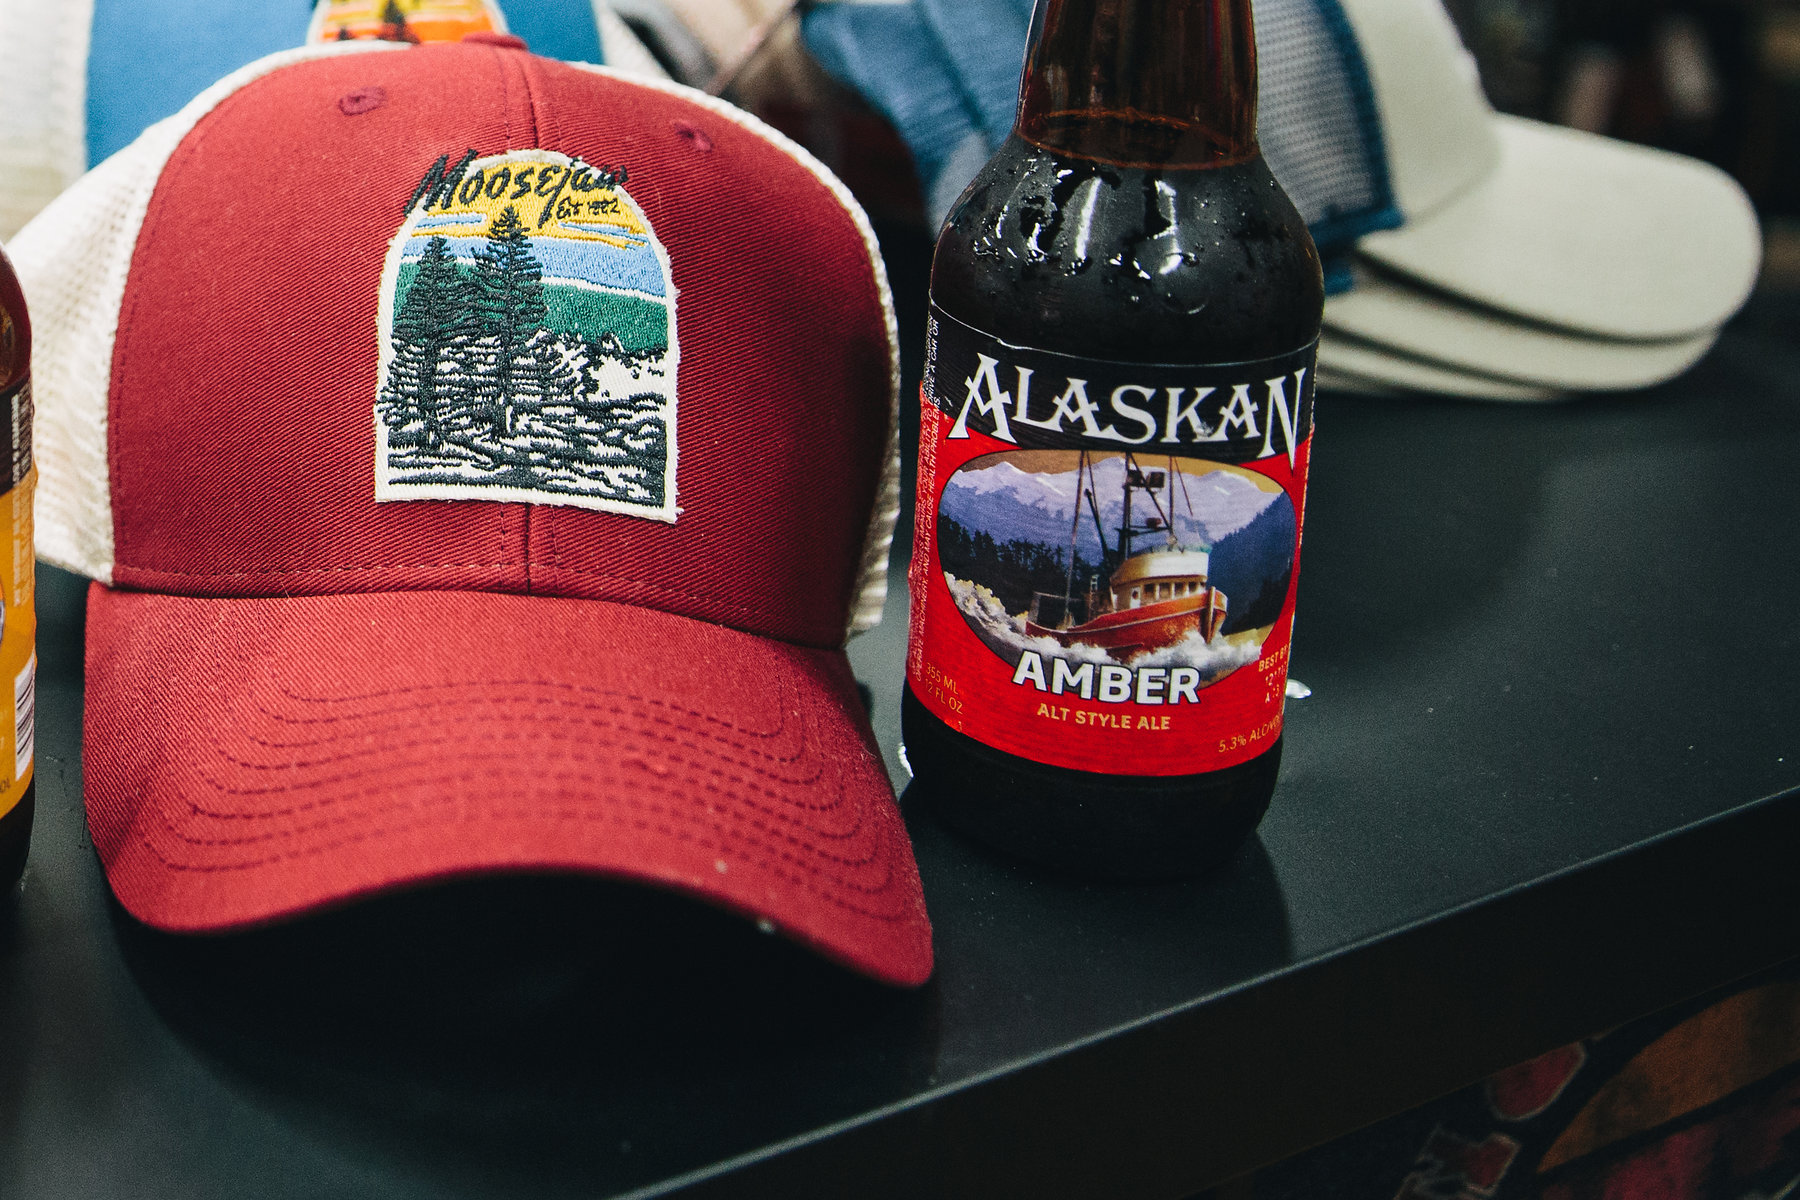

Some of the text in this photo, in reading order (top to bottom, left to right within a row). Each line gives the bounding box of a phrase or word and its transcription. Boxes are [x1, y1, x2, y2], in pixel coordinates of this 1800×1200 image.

[932, 319, 939, 338] OR
[930, 339, 938, 361] CAR
[927, 375, 936, 406] DRIVE
[926, 407, 934, 421] TO
[948, 352, 1307, 477] ALASKAN
[923, 421, 932, 465] ABILITY
[928, 455, 937, 493] HEALTH
[925, 498, 935, 531] CAUSE
[923, 531, 933, 556] MAY
[922, 556, 931, 577] AND
[1258, 651, 1279, 673] BEST
[925, 662, 959, 696] 355 ML
[1012, 650, 1201, 705] AMBER
[935, 686, 946, 705] FL
[948, 696, 964, 715] OZ
[1037, 702, 1171, 731] ALT STYLE ALE
[1218, 735, 1247, 753] 5.3%
